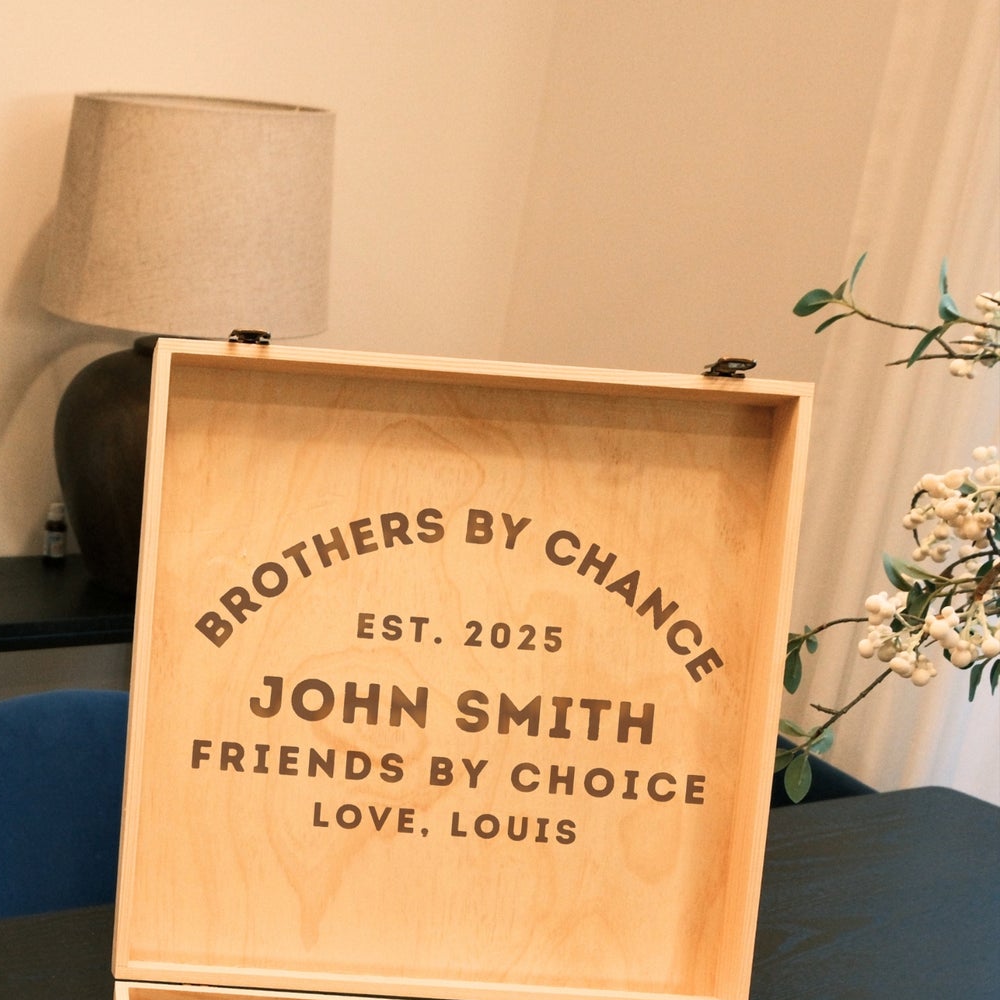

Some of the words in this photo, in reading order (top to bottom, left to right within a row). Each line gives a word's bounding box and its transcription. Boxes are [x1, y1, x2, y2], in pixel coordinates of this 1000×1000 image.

[194, 508, 445, 648] BROTHERS
[465, 508, 532, 550] BY
[545, 530, 724, 683] CHANCE
[357, 613, 443, 644] EST.
[464, 620, 563, 652] 2025
[249, 675, 428, 729] JOHN
[456, 689, 655, 745] SMITH
[191, 739, 405, 783] FRIENDS
[429, 756, 489, 789] BY
[510, 762, 707, 805] CHOICE
[312, 802, 429, 838] LOVE,
[451, 811, 577, 845] LOUIS
